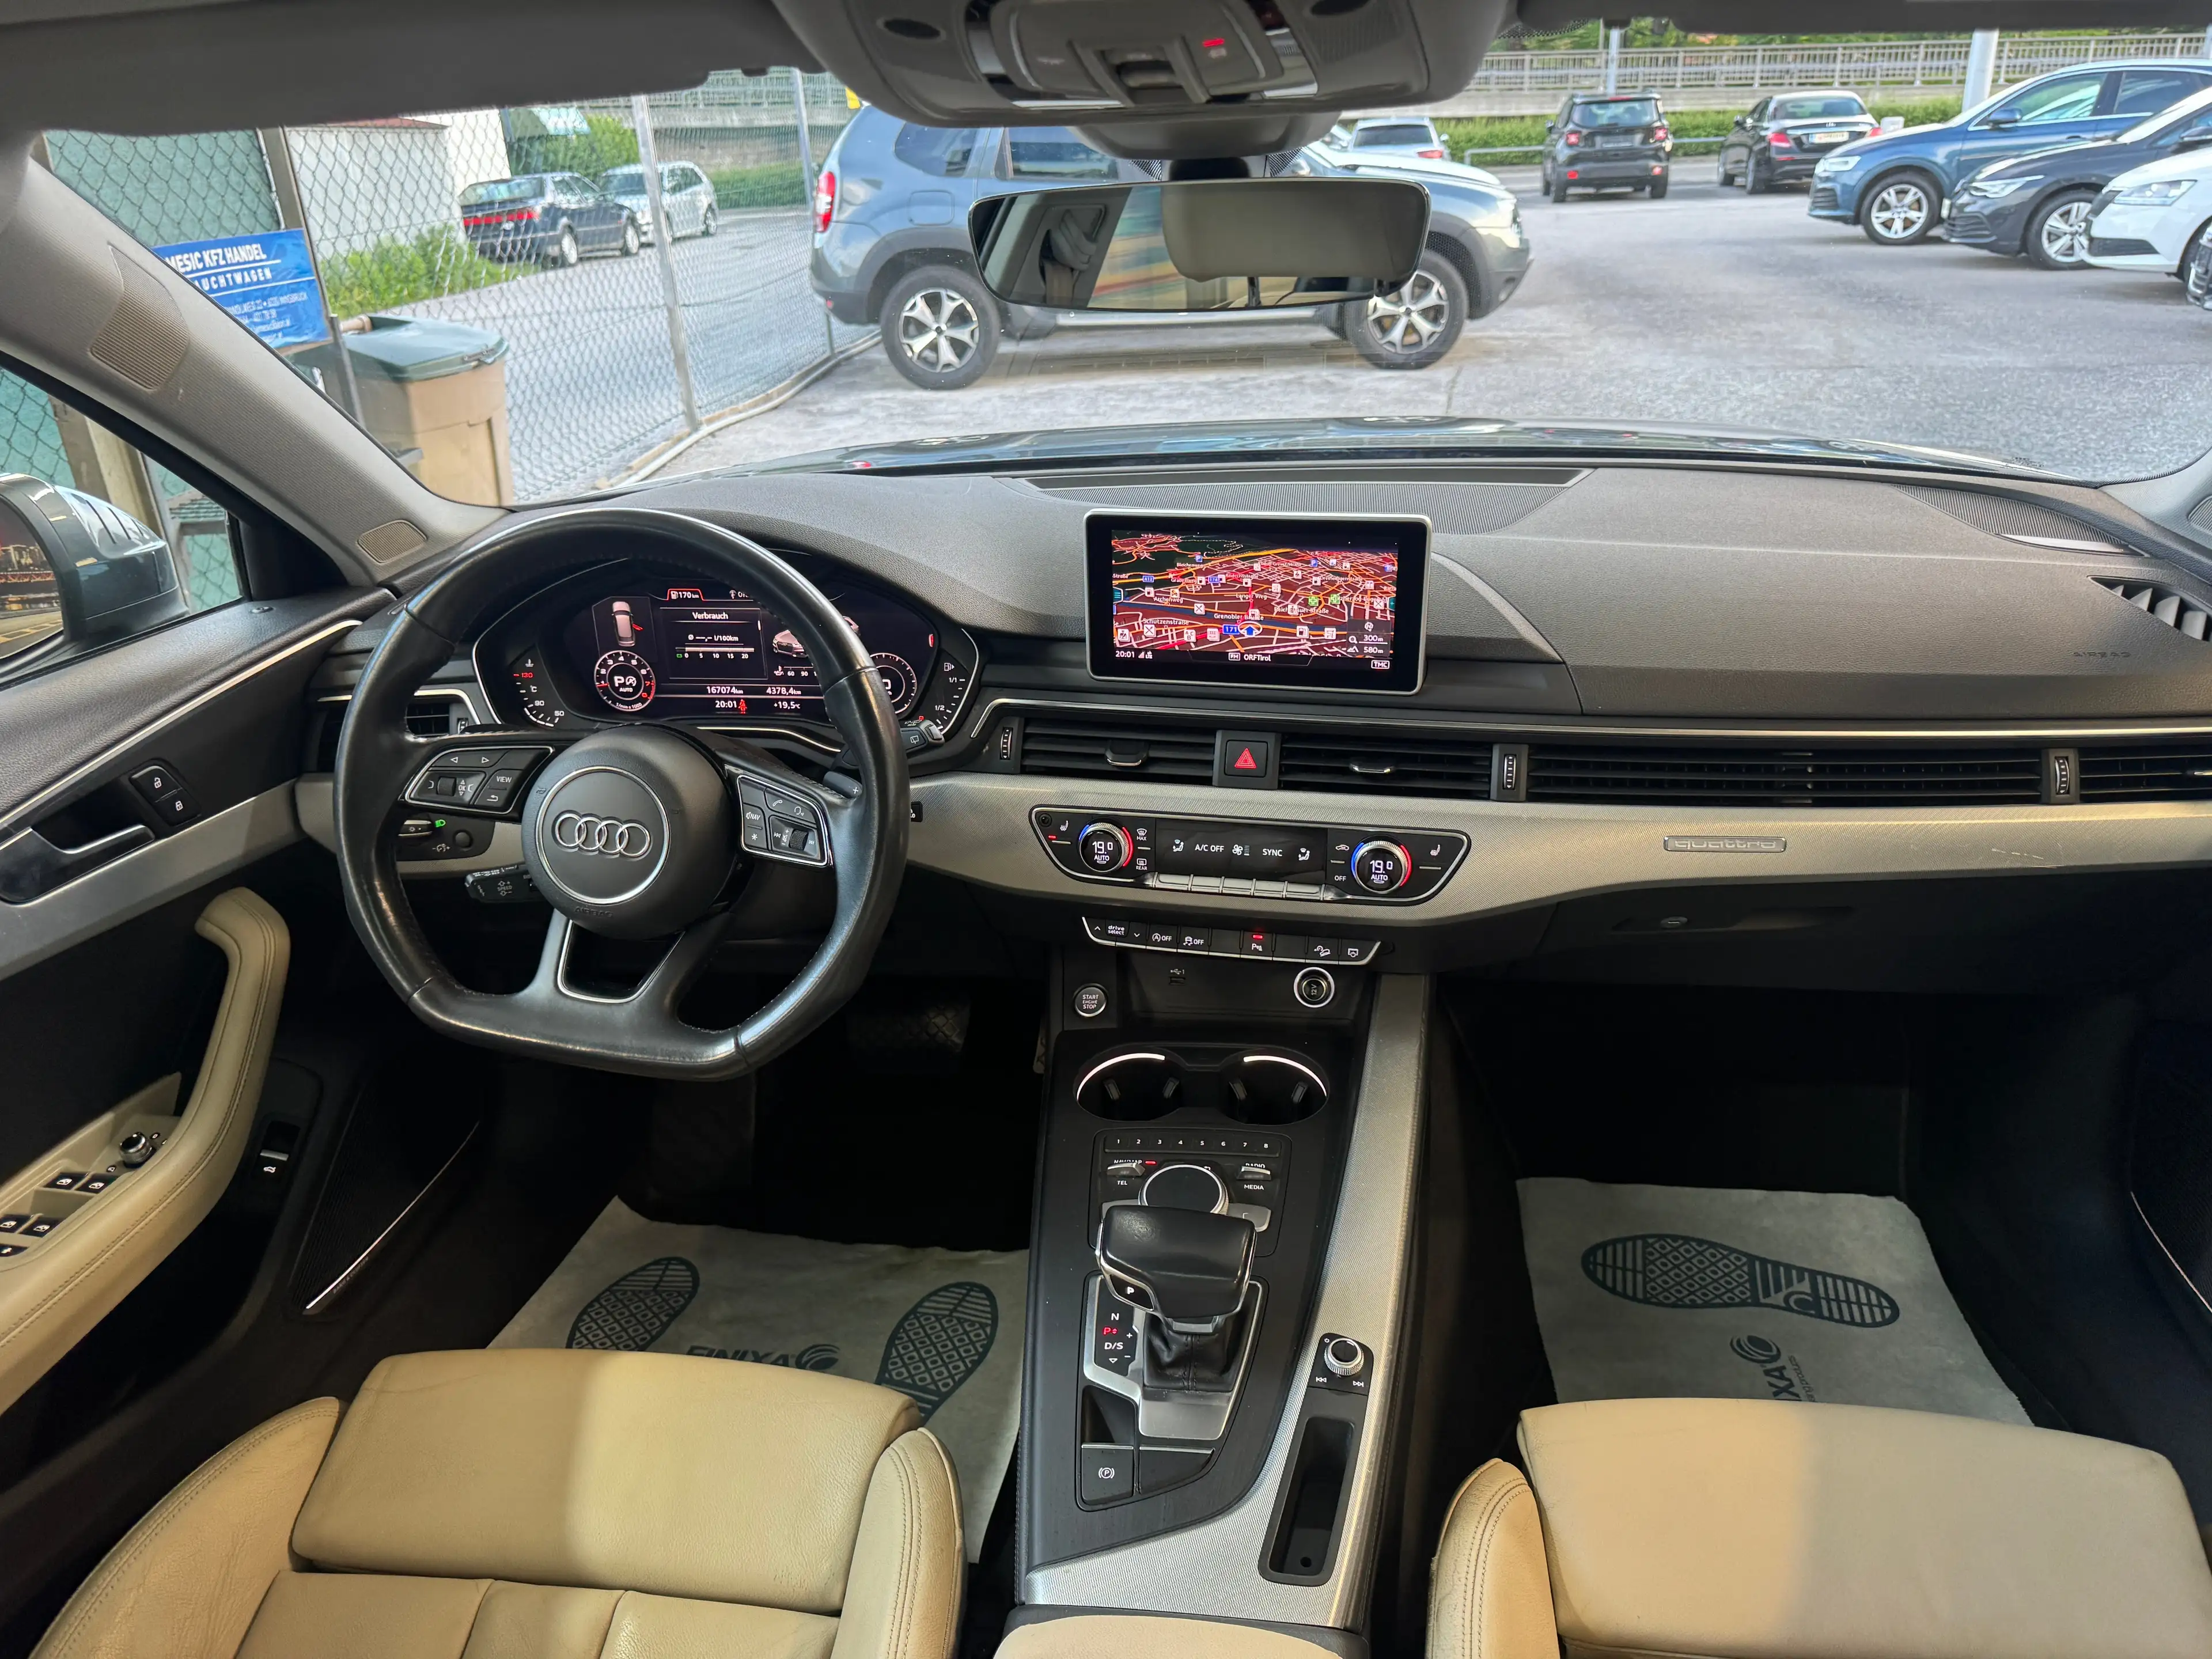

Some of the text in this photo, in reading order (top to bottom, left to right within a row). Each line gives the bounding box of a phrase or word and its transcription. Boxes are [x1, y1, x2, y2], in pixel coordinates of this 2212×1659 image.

[204, 248, 224, 267] KFZ
[224, 244, 267, 263] HANDEL
[692, 612, 729, 620] Verbrauch
[613, 676, 624, 687] P
[750, 812, 760, 821] NAV
[1675, 839, 1777, 850] quattro
[1262, 848, 1283, 857] SYNC
[574, 906, 613, 918] AIRBAG
[1126, 1286, 1134, 1295] P
[1111, 1312, 1119, 1320] N
[1104, 1341, 1123, 1350] D/S
